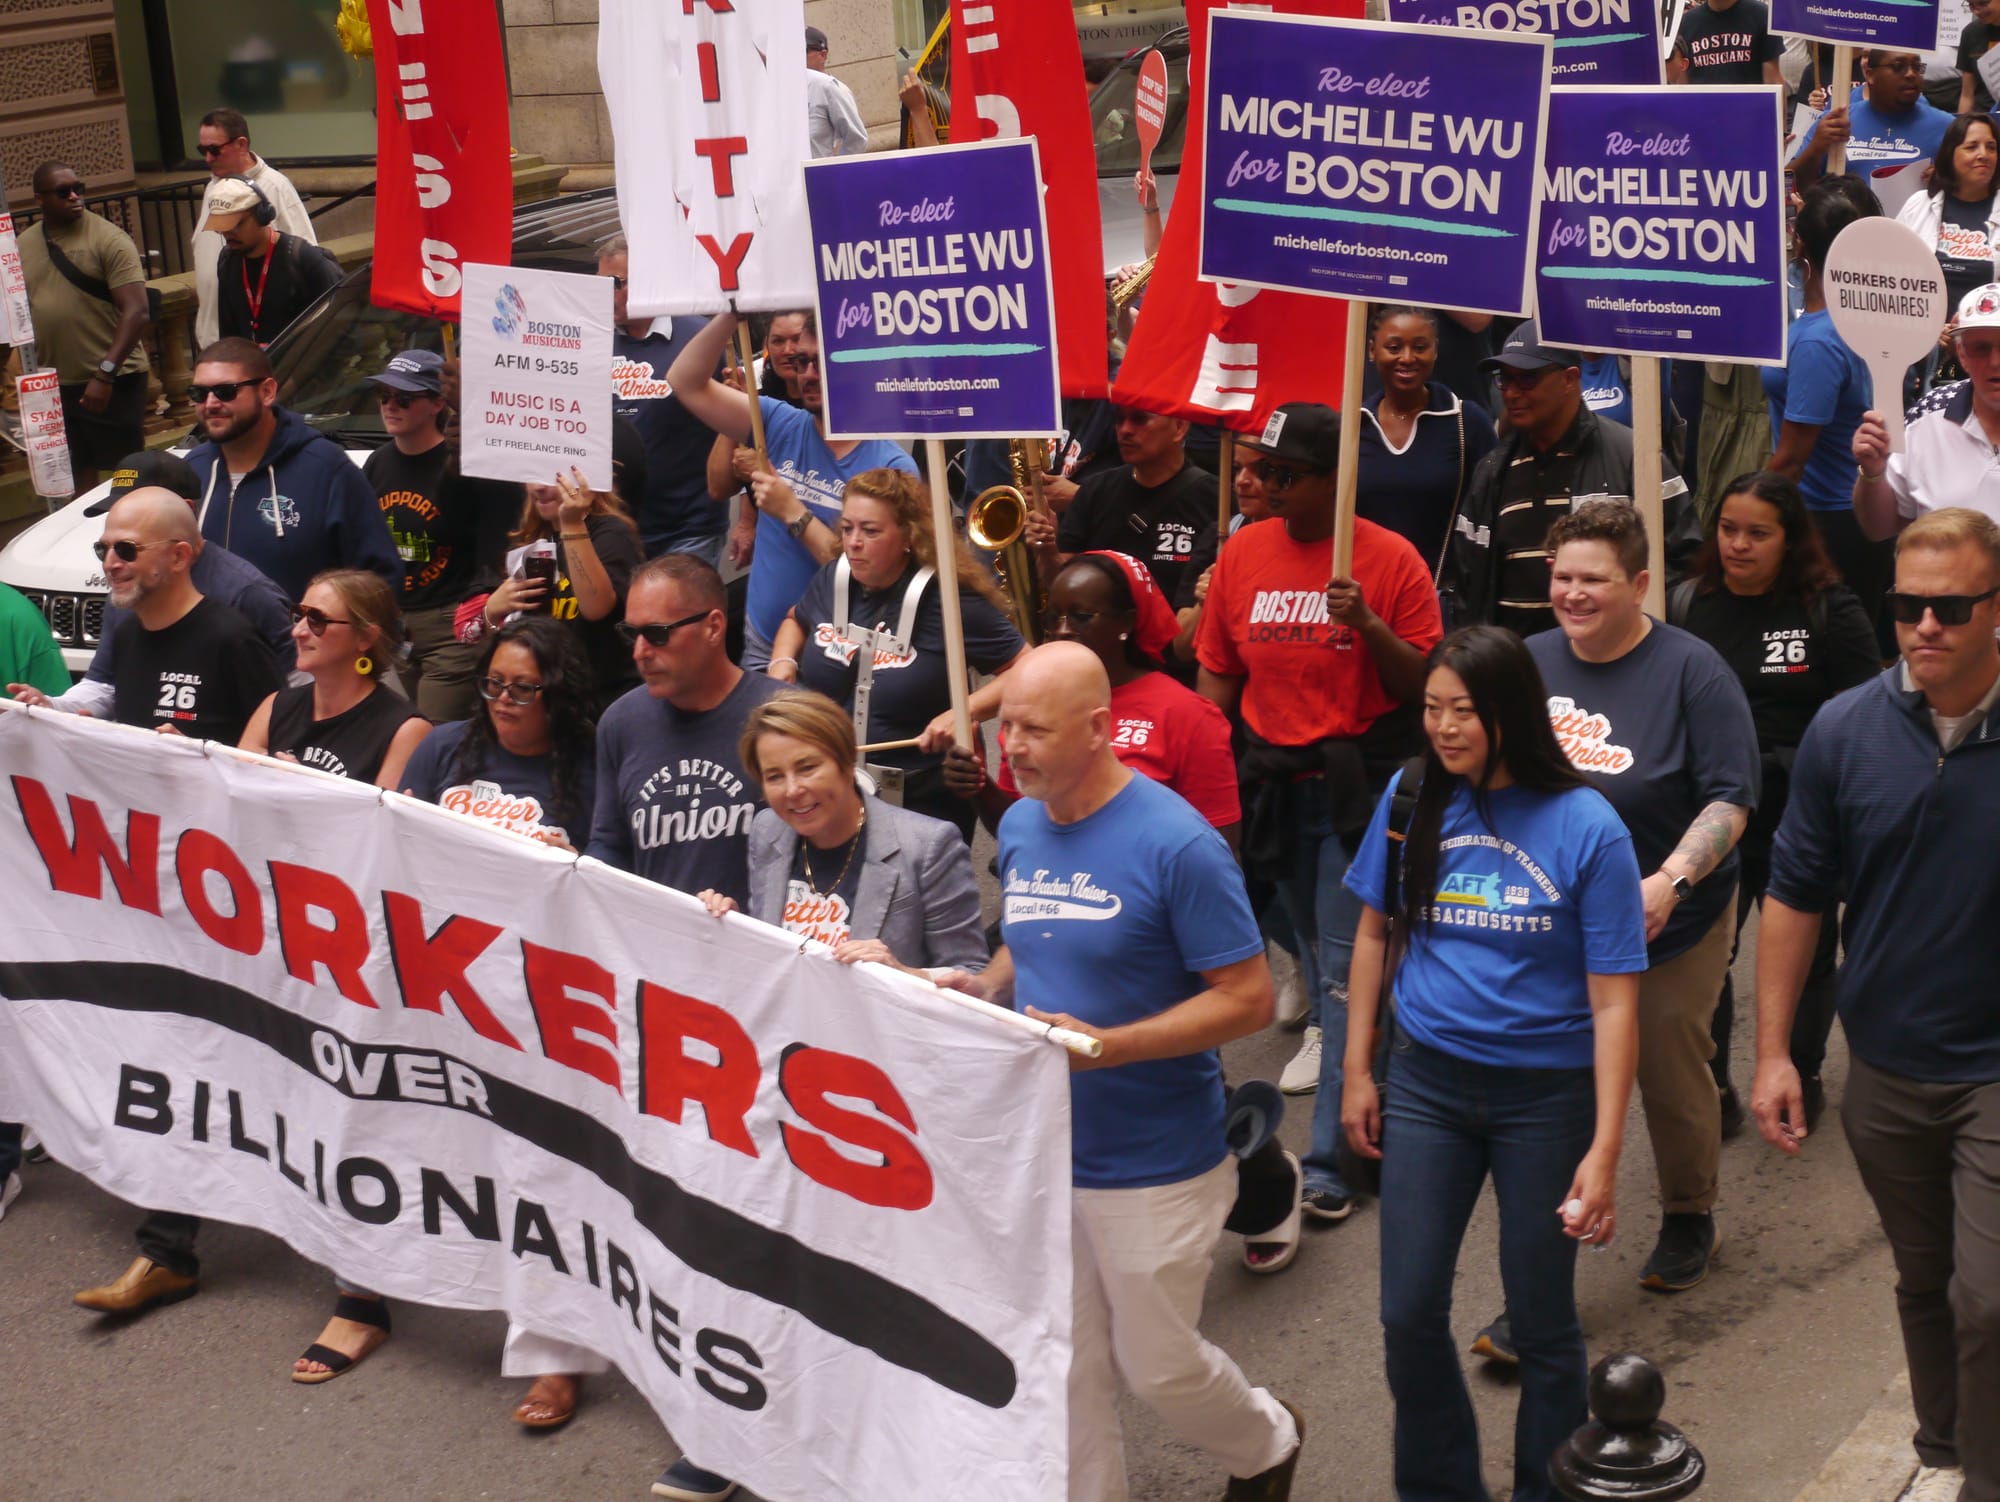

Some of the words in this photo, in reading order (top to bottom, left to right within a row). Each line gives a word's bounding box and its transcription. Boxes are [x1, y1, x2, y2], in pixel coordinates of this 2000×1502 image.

[1456, 0, 1631, 33] BOSTON
[1807, 5, 1898, 23] michelleforboston.com
[1691, 32, 1752, 54] BOSTON
[1693, 50, 1751, 67] MUSICIANS
[1316, 67, 1431, 99] Re-elect
[1219, 94, 1435, 151] MICHELLE
[1443, 114, 1524, 159] WU
[682, 0, 754, 291] ITY
[1606, 131, 1691, 157] Re-elect
[1226, 150, 1282, 187] for
[1286, 151, 1502, 215] BOSTON
[1543, 166, 1699, 206] MICHELLE
[1703, 170, 1768, 208] WU
[878, 196, 955, 227] Re-elect
[1273, 234, 1448, 265] michelleforboston.com
[1548, 217, 1588, 255] for
[1589, 216, 1756, 264] BOSTON
[820, 234, 967, 282] MICHELLE
[968, 228, 1034, 272] WU
[1830, 269, 1897, 289] WORKERS
[1900, 277, 1938, 294] OVER
[836, 298, 872, 338] for
[872, 283, 1028, 336] BOSTON
[1586, 297, 1721, 317] michelleforboston.com
[1840, 289, 1929, 318] BILLIONAIRES!
[528, 321, 581, 338] BOSTON
[522, 334, 582, 350] MUSICIANS
[494, 353, 530, 370] AFM
[535, 358, 579, 376] 9-535
[612, 365, 650, 379] etter
[619, 381, 667, 397] Union
[875, 377, 1000, 393] michelleforboston.com
[491, 391, 544, 410] MUSIC
[550, 398, 565, 412] IS
[570, 400, 581, 414] A
[485, 412, 515, 426] DAY
[519, 415, 550, 430] JOB
[555, 419, 587, 435] TOO
[485, 438, 502, 447] LET
[505, 440, 561, 455] FREELANCE
[563, 446, 587, 457] RING
[379, 491, 439, 521] UPPORT
[1157, 522, 1196, 535] LOCAL
[1157, 533, 1192, 553] 26
[1248, 625, 1319, 643] LOCAL
[1327, 626, 1353, 643] 26
[1762, 629, 1810, 641] LOCAL
[1764, 640, 1806, 663] 26
[160, 672, 202, 685] LOCAL
[158, 684, 196, 709] 26
[1113, 726, 1149, 745] 26
[1117, 719, 1154, 729] LOCAL
[1551, 712, 1606, 739] etter
[639, 766, 672, 801] IT'S
[679, 758, 744, 798] BETTER
[675, 784, 690, 796] IN
[693, 783, 702, 795] A
[474, 785, 496, 801] IT'S
[444, 790, 538, 822] Better
[632, 798, 755, 850] Union
[1502, 841, 1518, 855] OF
[1515, 849, 1561, 903] TEACHERS
[1071, 872, 1108, 902] Union
[1444, 876, 1488, 895] AFT
[784, 899, 844, 923] etter
[1010, 903, 1038, 914] Local
[1039, 904, 1061, 914] #66
[10, 774, 934, 1210] WORKERS
[311, 1031, 492, 1117] OVER
[114, 1064, 767, 1411] BILLIONAIRES
